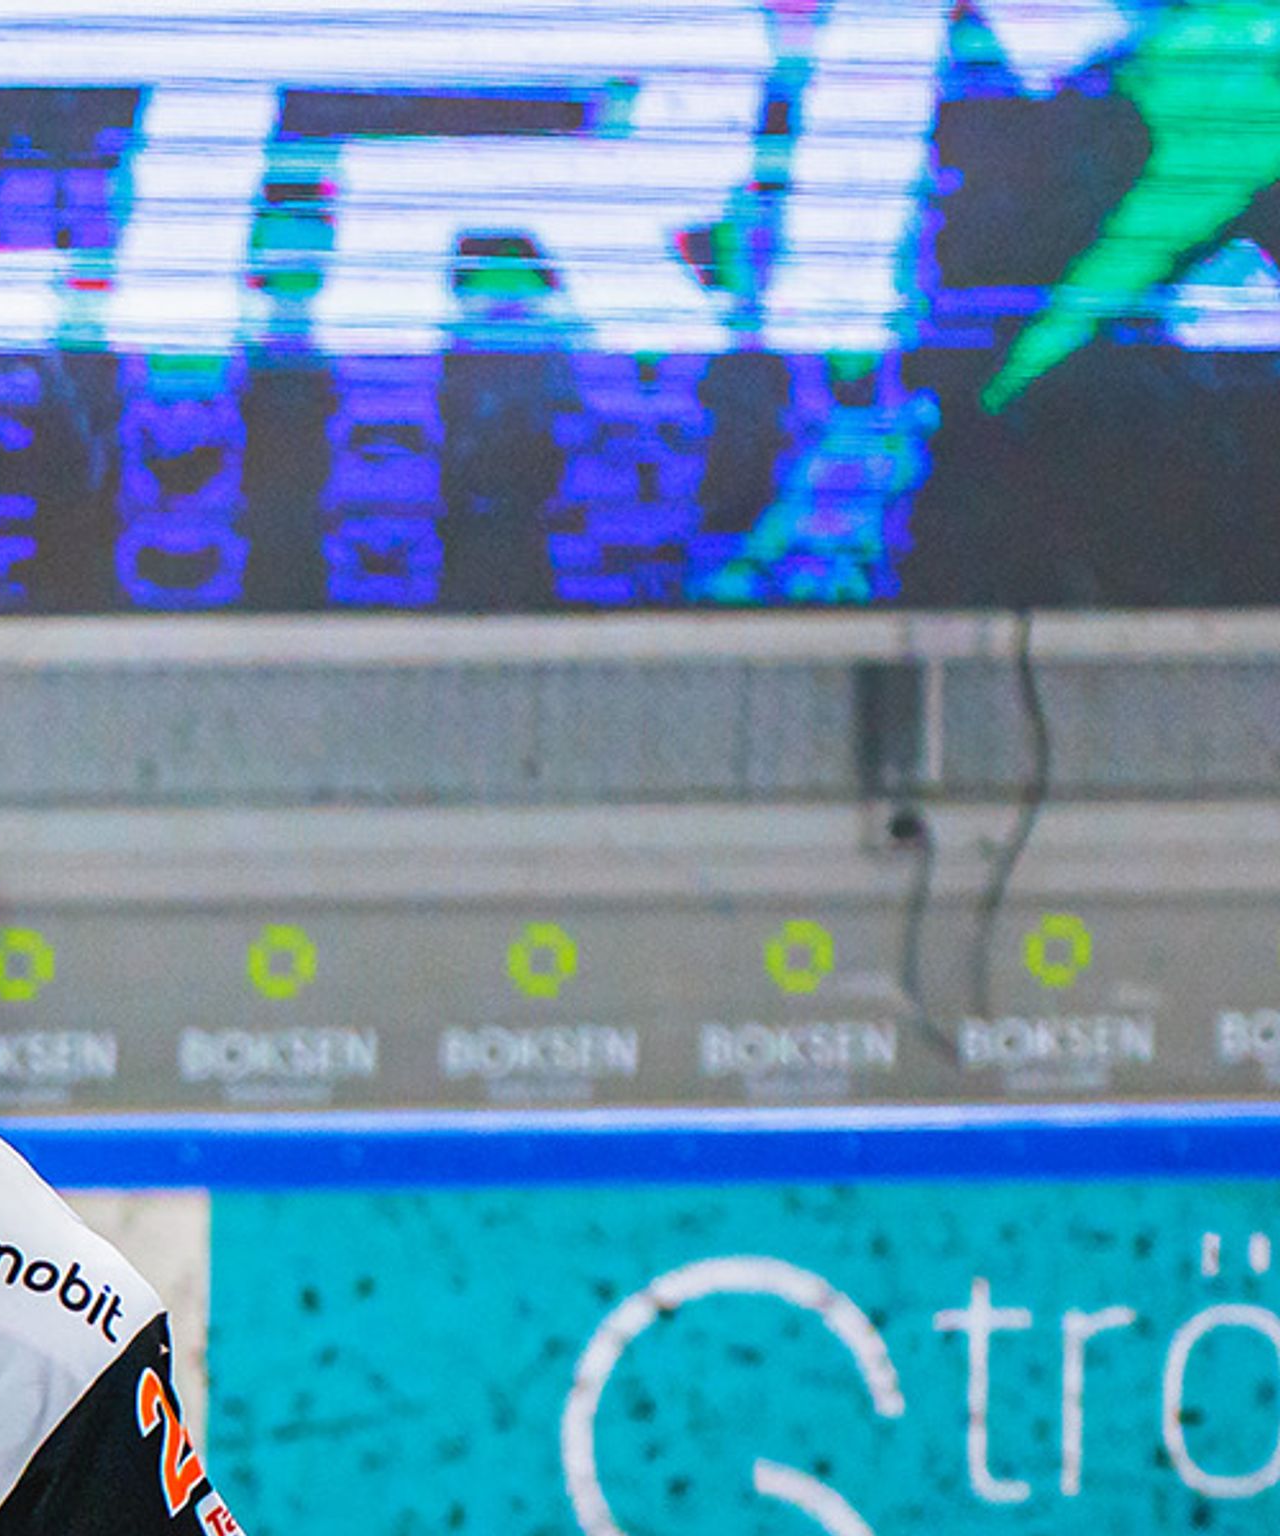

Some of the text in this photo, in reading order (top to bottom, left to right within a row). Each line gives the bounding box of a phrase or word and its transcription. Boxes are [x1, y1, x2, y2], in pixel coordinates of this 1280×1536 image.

[178, 1026, 377, 1081] BOKSEN
[443, 1025, 638, 1080] BOKSEN
[698, 1020, 897, 1075] BOKSEN
[958, 1014, 1154, 1069] BOKSEN
